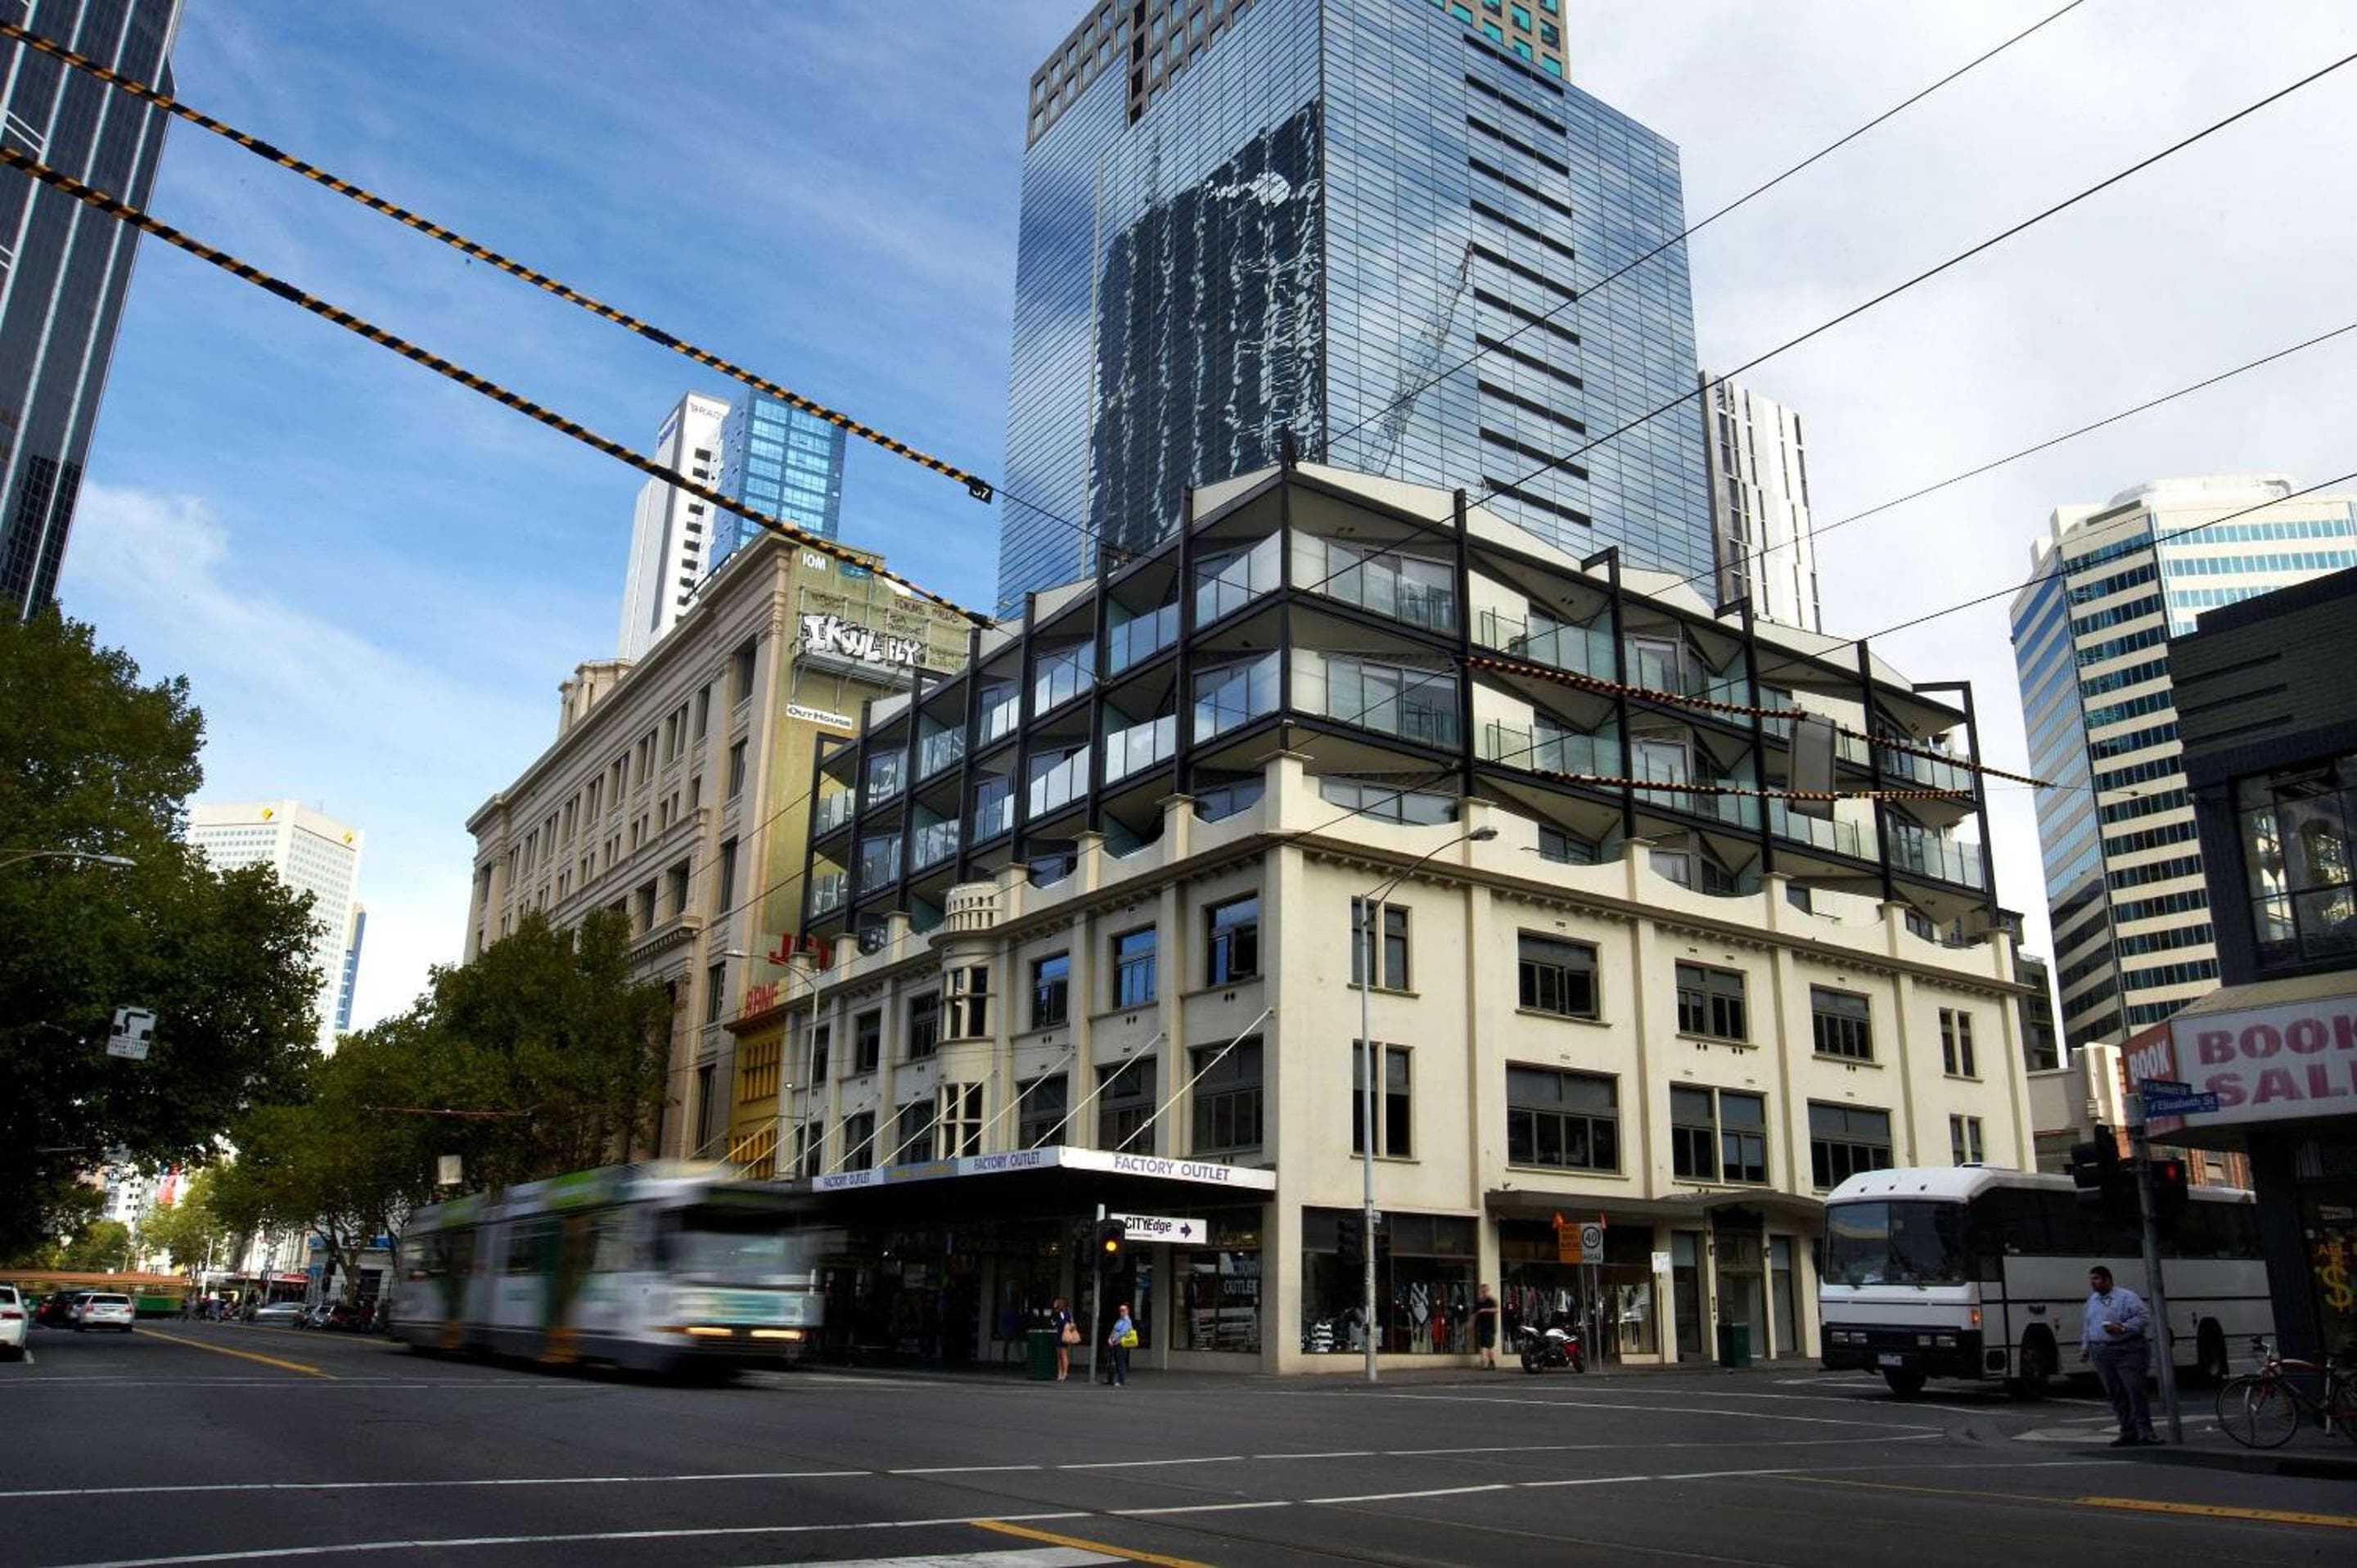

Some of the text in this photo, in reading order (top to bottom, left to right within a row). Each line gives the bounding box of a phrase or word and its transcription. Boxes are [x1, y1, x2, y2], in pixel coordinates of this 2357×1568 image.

[2129, 1039, 2170, 1086] BOOK
[2204, 1061, 2357, 1107] SAL
[974, 1151, 1040, 1170] FACTORY OUTLET
[1114, 1156, 1230, 1181] FACTORY OUTLET
[823, 1172, 870, 1187] FACTORY OUTLET
[1585, 1231, 1597, 1244] 40
